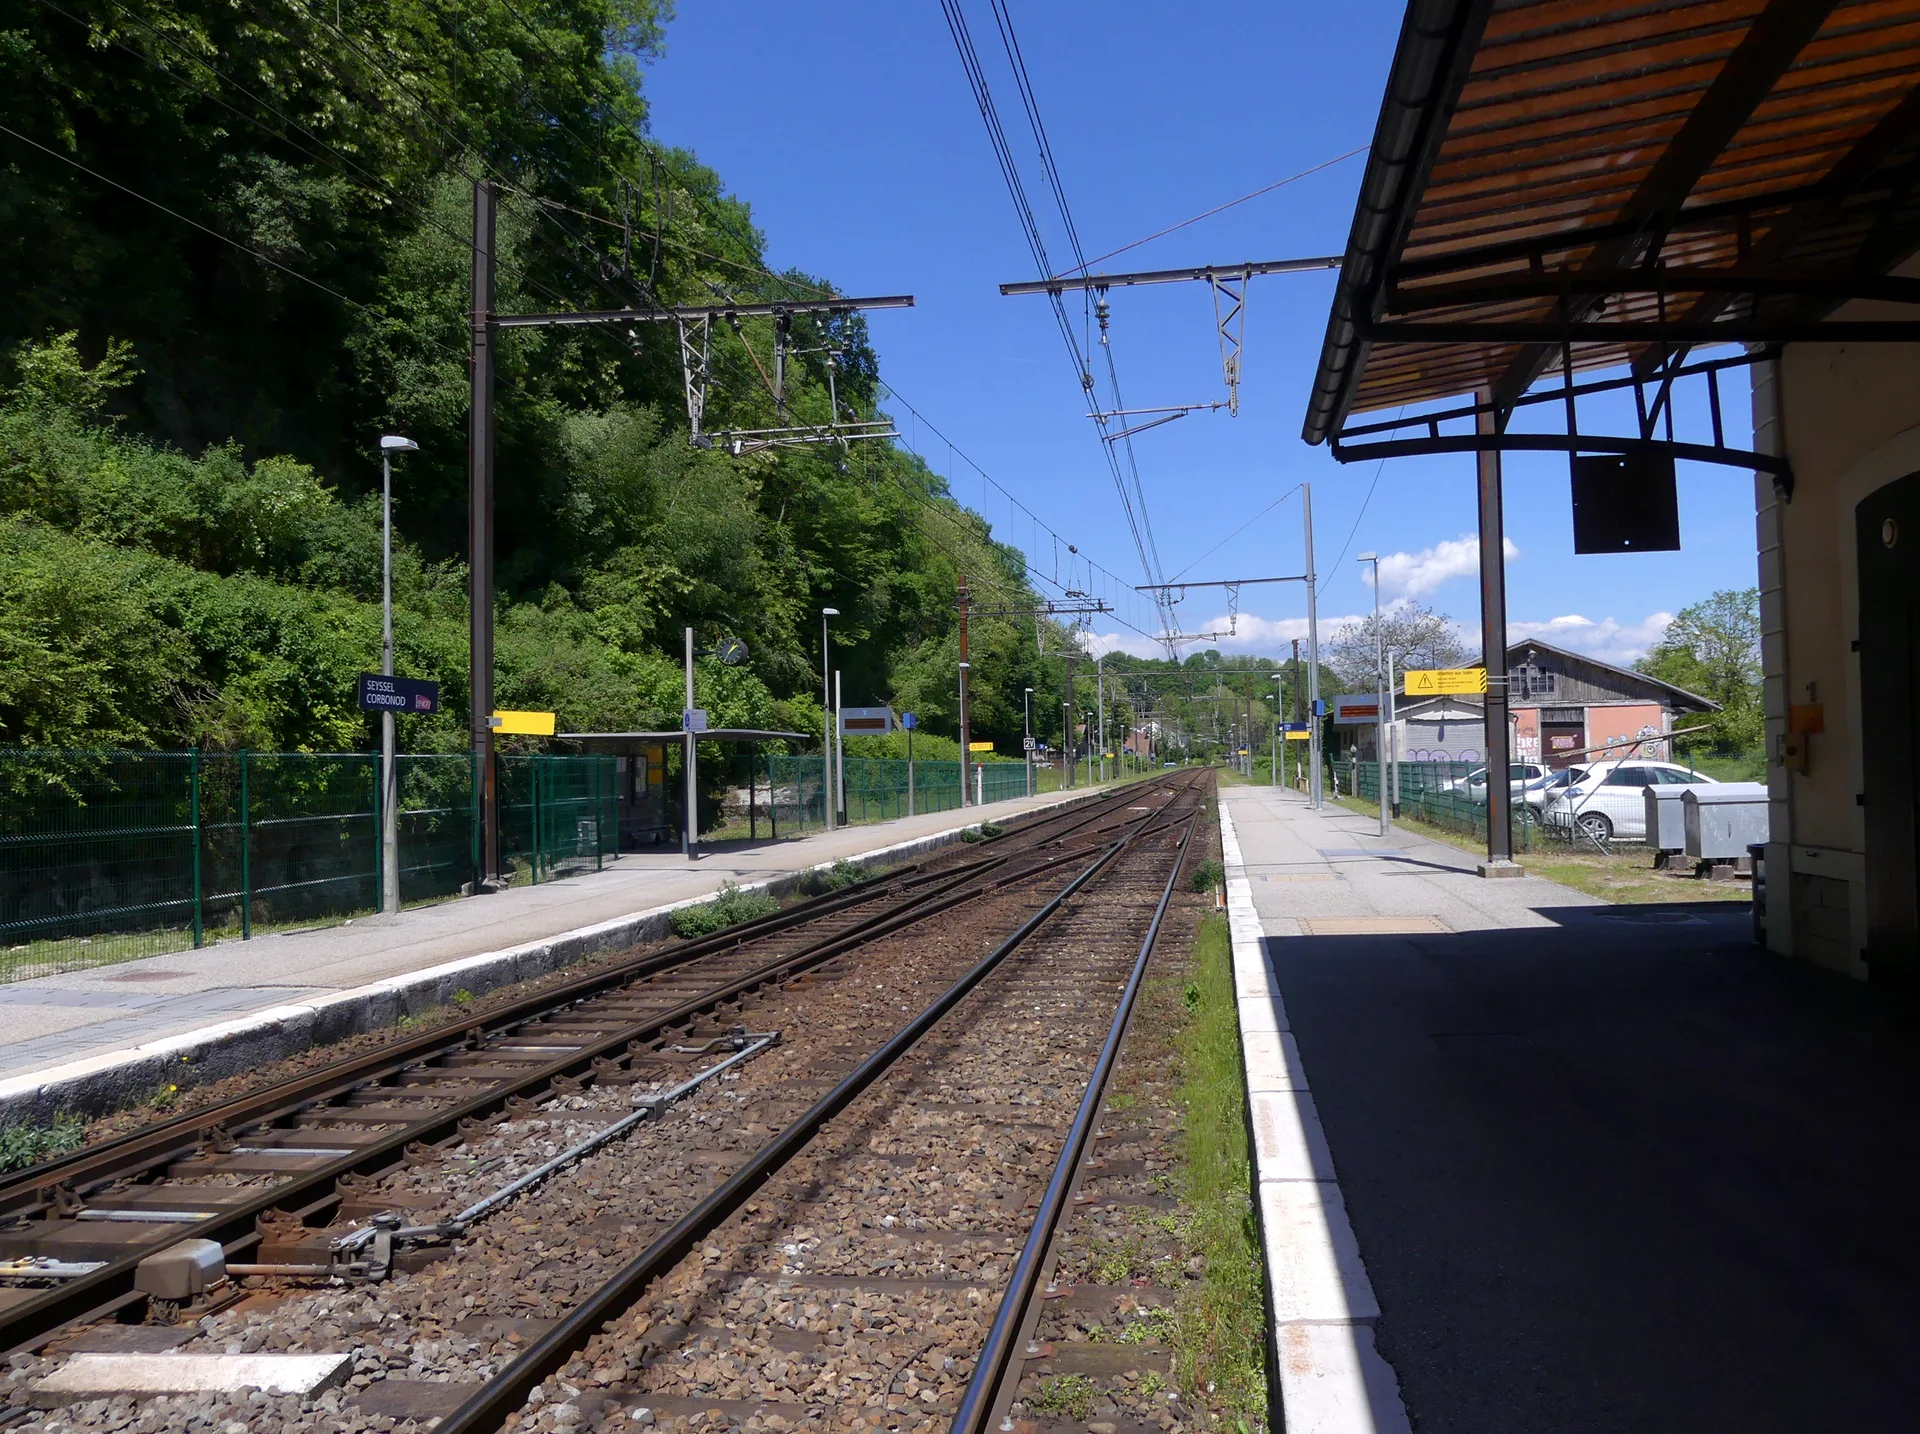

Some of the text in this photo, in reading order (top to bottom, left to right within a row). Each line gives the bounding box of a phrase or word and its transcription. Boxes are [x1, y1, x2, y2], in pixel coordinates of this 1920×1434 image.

[366, 680, 395, 693] SEYSSEL
[366, 693, 406, 706] CORBONOD
[1025, 740, 1034, 748] 2V
